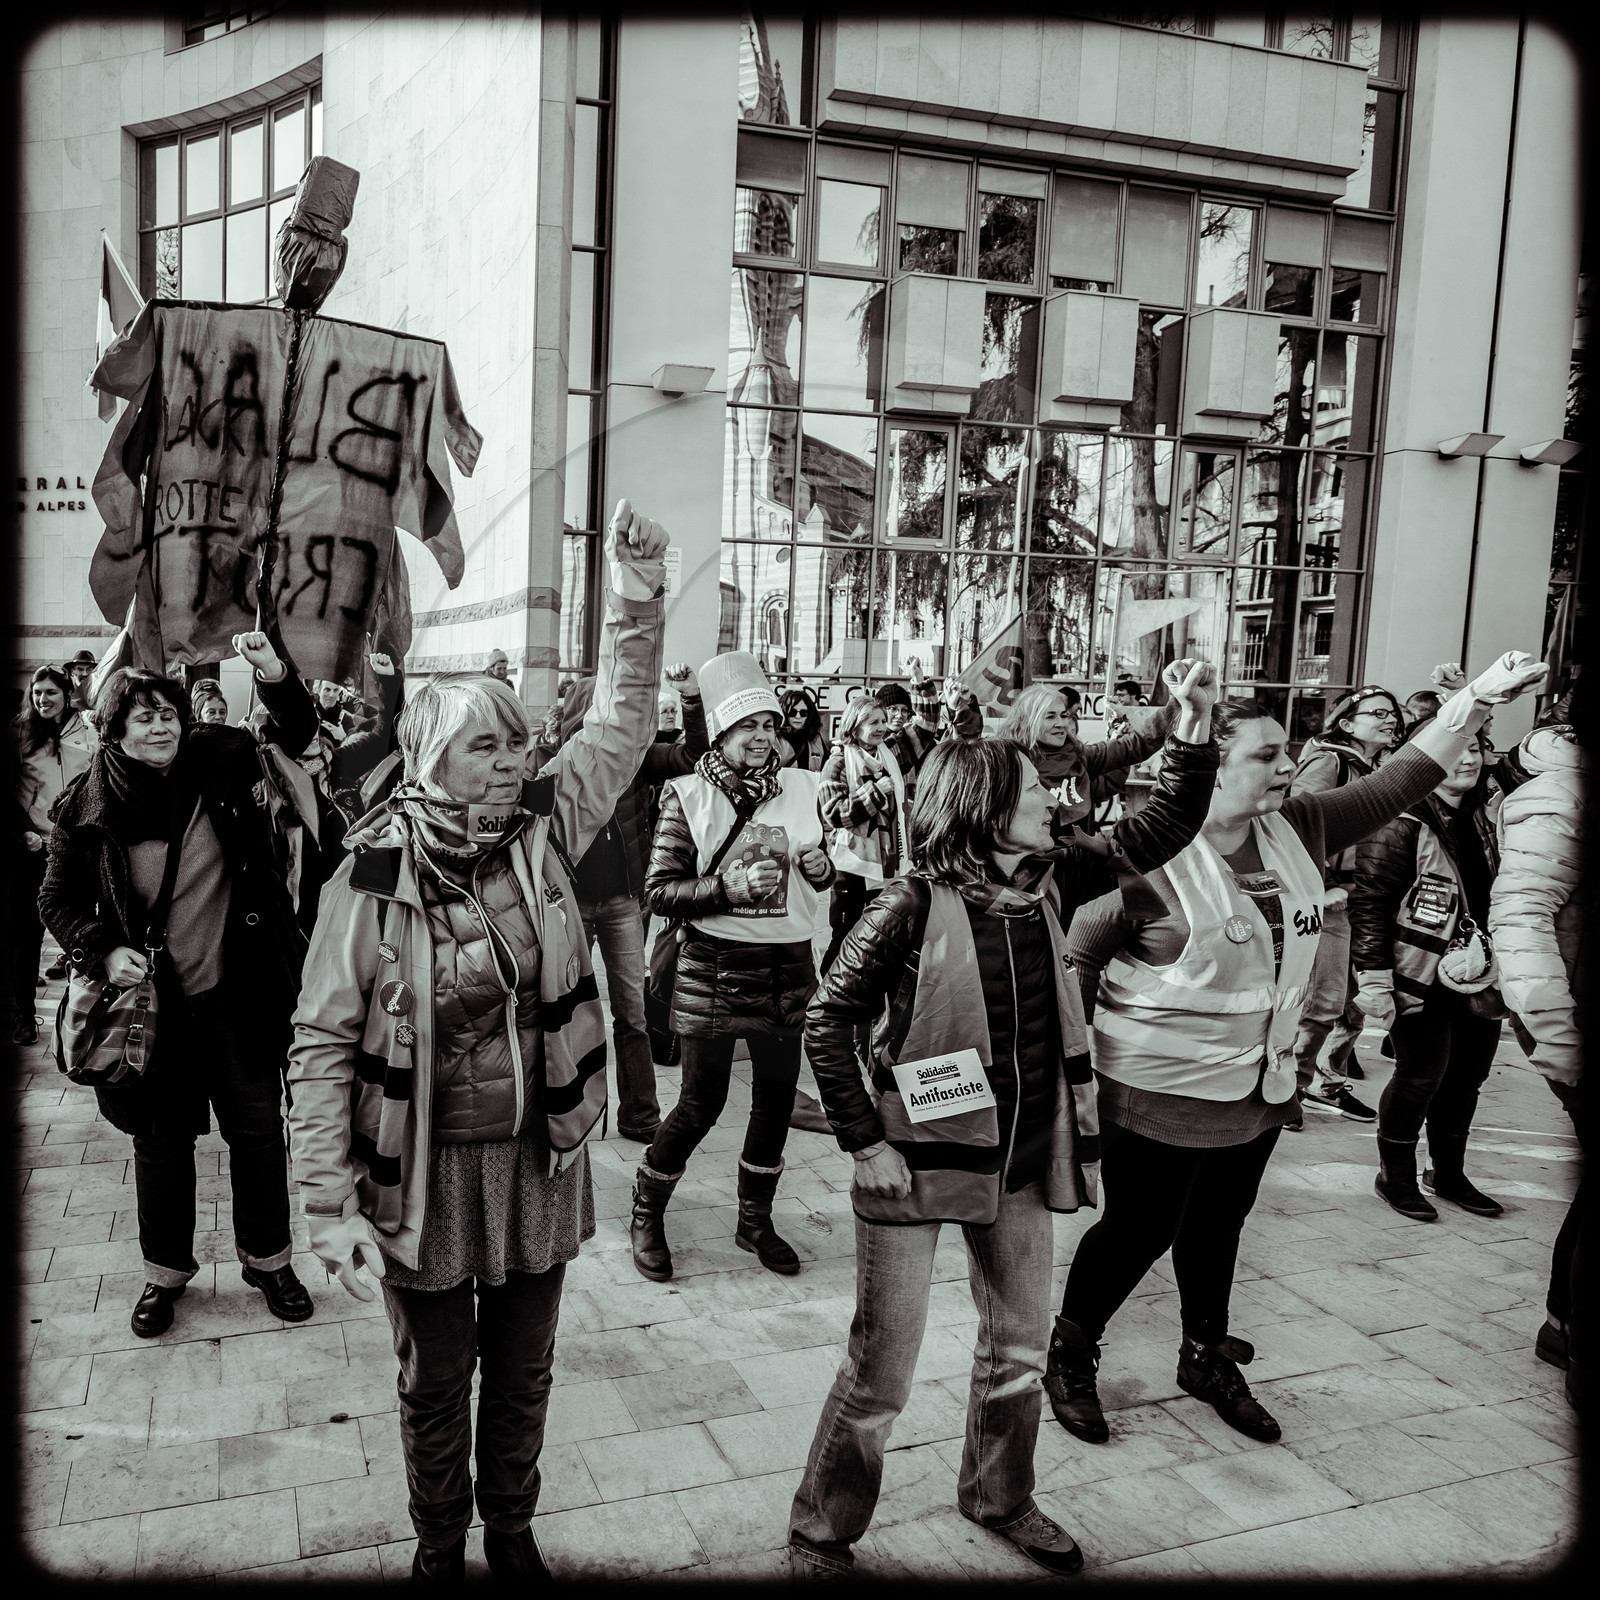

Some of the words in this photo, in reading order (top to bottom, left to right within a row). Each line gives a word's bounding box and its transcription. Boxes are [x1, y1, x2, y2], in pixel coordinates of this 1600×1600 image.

[36, 501, 87, 512] ALPES
[732, 907, 757, 915] métier
[916, 1063, 959, 1080] Solidaires
[909, 1081, 984, 1107] Antifasciste
